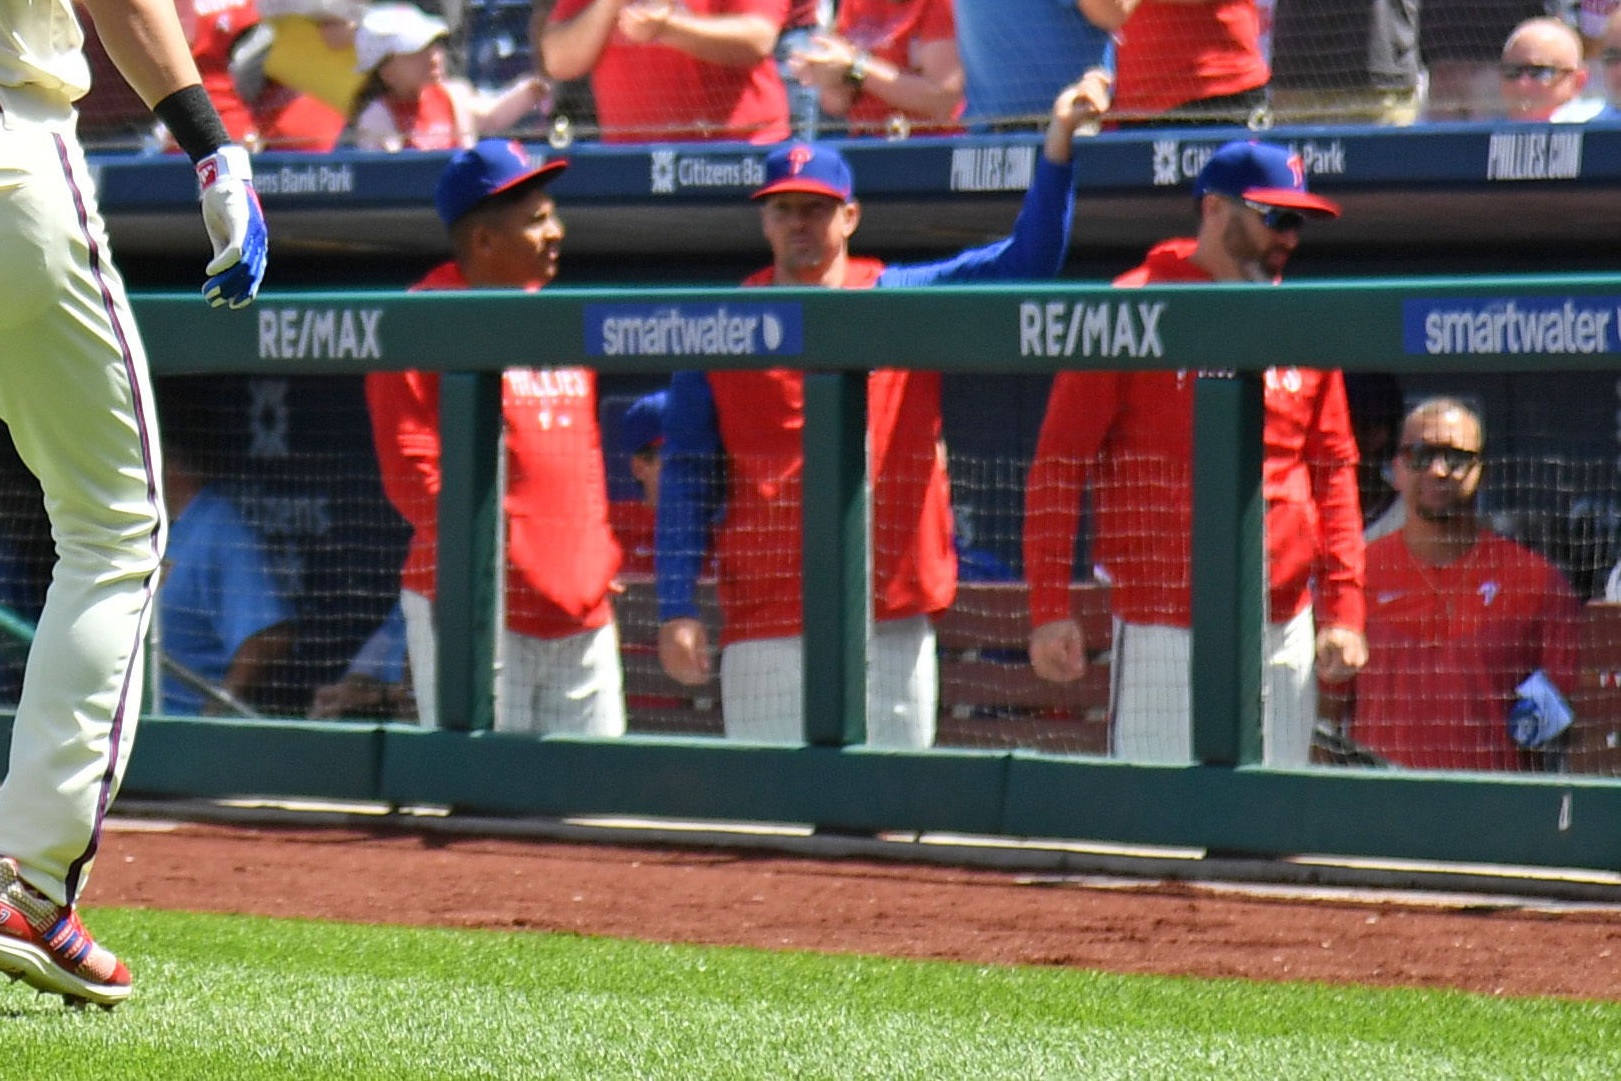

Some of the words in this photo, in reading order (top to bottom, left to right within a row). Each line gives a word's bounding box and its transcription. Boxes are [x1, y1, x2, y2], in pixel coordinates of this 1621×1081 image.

[281, 166, 316, 193] Bank
[319, 164, 352, 192] Park
[678, 157, 739, 186] Citizens
[1302, 141, 1346, 174] Park
[1486, 132, 1583, 181] PHILLIES.COM
[258, 308, 383, 359] RE/MAX
[602, 308, 758, 356] smartwater
[1018, 301, 1167, 357] RE/MAX
[1424, 300, 1610, 355] smartwater
